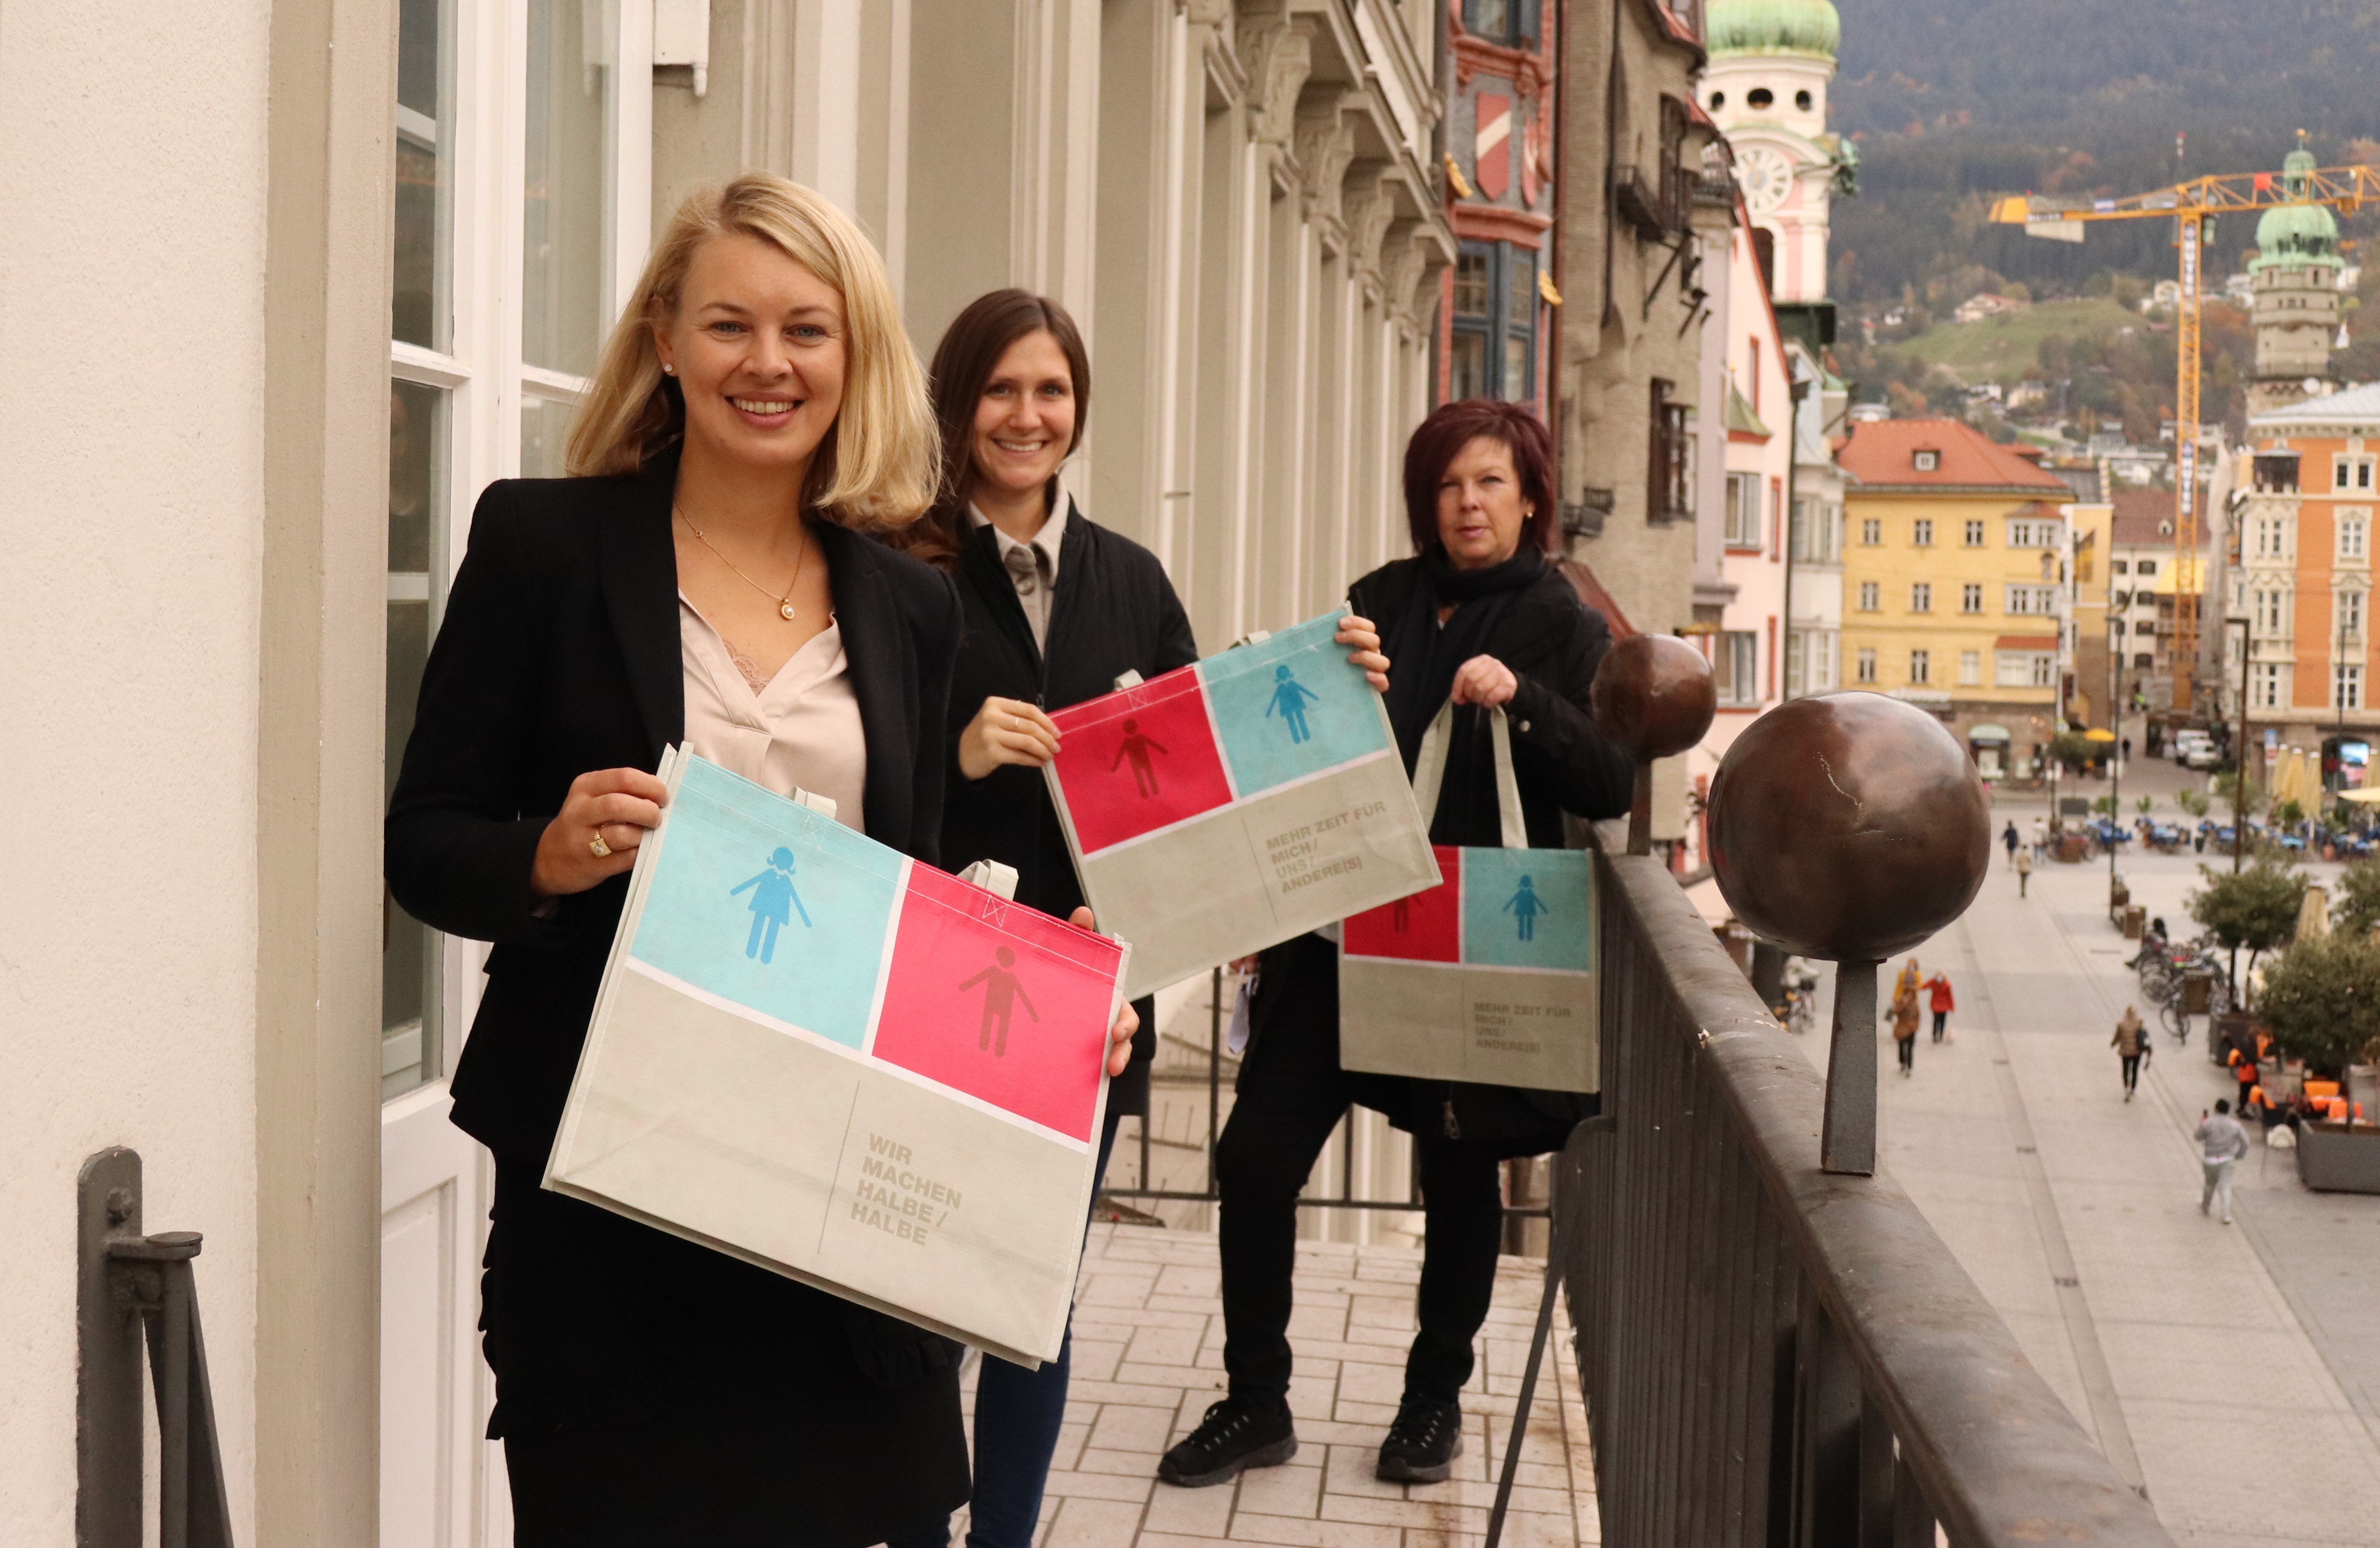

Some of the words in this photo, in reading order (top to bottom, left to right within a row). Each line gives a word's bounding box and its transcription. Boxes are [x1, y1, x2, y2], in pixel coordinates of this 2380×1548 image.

[1266, 827, 1312, 850] MEHR
[1315, 812, 1349, 833] ZEIT
[1354, 801, 1386, 820] FÜR
[1282, 856, 1363, 893] ANDERE(S)
[869, 1132, 913, 1165] WIR
[862, 1155, 962, 1209] MACHEN
[850, 1202, 928, 1246] HALBE
